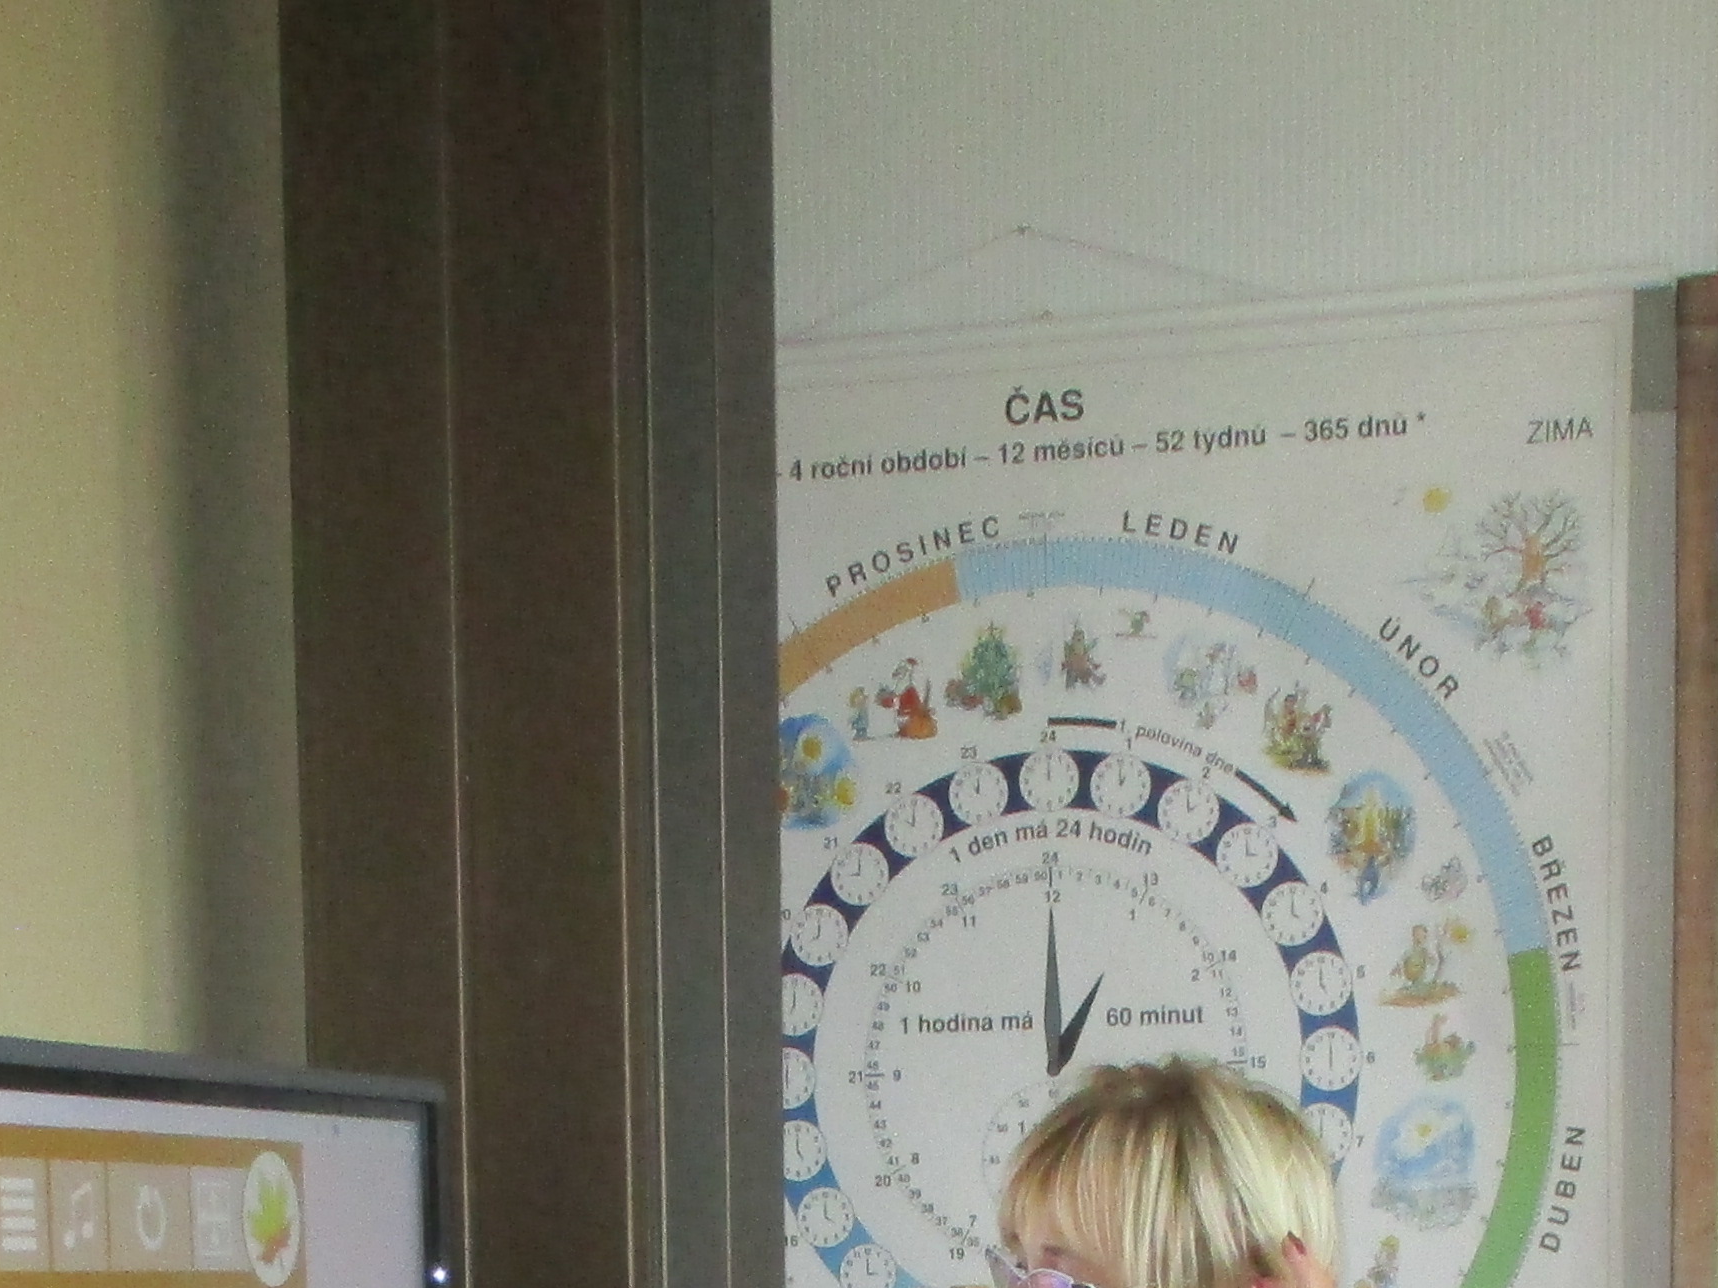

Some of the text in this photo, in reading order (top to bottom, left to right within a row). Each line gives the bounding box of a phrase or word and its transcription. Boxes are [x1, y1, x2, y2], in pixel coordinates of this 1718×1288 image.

[1004, 385, 1085, 426] ČAS
[789, 459, 803, 481] 4
[810, 454, 873, 481] roční
[880, 446, 968, 475] období
[998, 441, 1025, 465] 12
[1033, 432, 1125, 462] měsíců
[1155, 429, 1185, 454] 52
[1194, 423, 1266, 455] týdnů
[1303, 417, 1349, 443] 365
[1526, 416, 1594, 444] ZIMA
[824, 515, 1001, 598] PROSINEC
[1121, 510, 1240, 555] LEDEN
[1377, 612, 1460, 700] ÚNOR
[1134, 725, 1203, 758] polovina
[1204, 751, 1234, 775] dne
[948, 818, 1153, 864] 1 den má 24 hodin
[1530, 834, 1582, 974] BŘEZEN
[900, 1010, 1034, 1035] 1 hodina má
[1105, 1004, 1204, 1027] 60 minut
[1538, 1125, 1586, 1254] DUBEN
